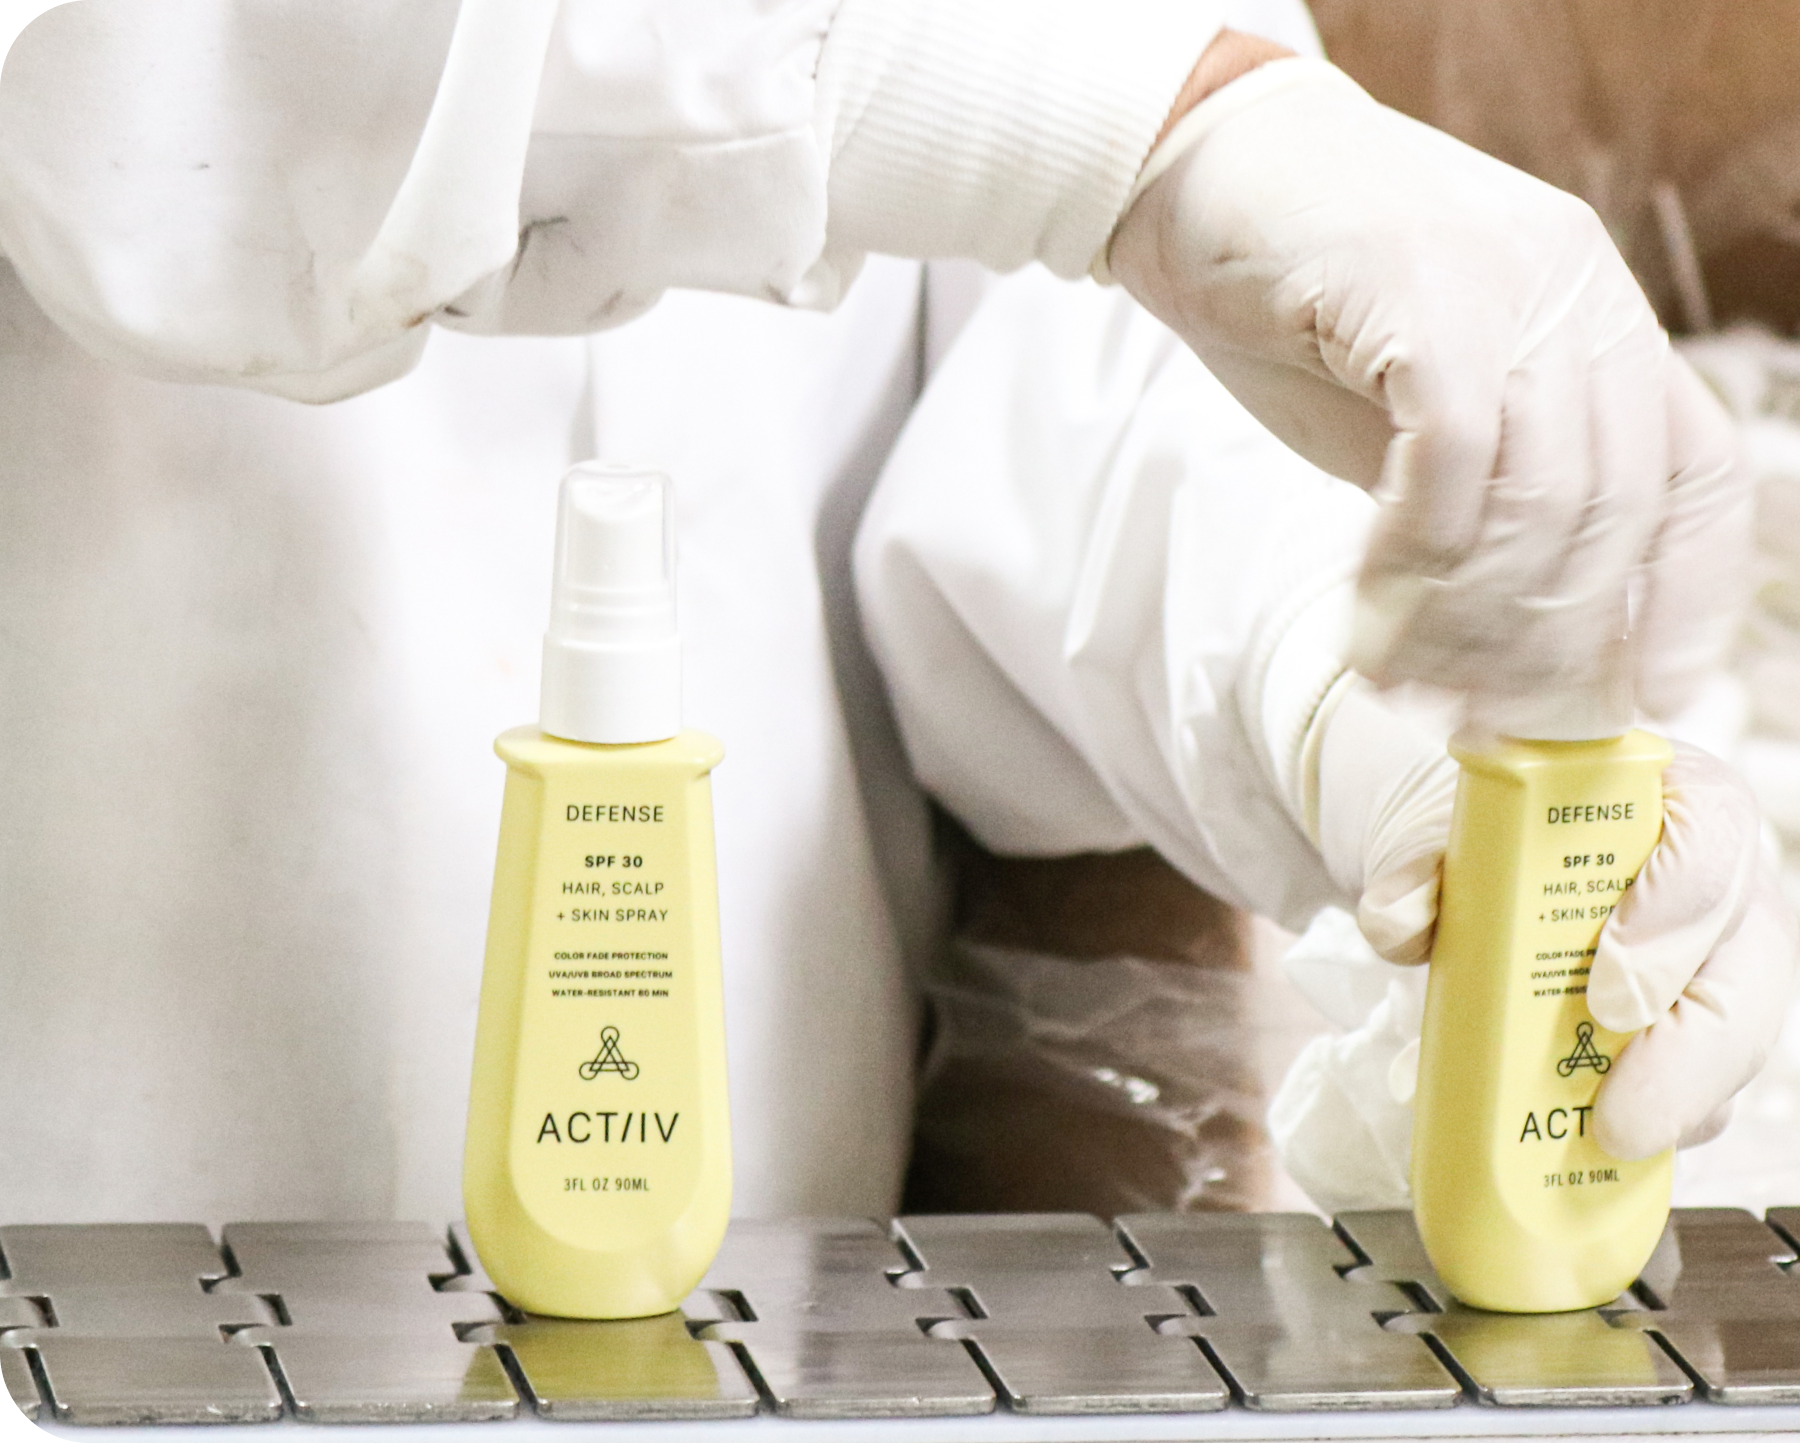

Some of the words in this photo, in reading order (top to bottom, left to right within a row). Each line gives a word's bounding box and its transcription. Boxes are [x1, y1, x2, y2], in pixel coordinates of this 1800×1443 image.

[566, 805, 664, 822] DEFENSE
[1548, 803, 1634, 824] DEFENSE
[585, 855, 616, 868] SPF
[622, 855, 643, 868] 30
[1563, 855, 1590, 868] SPF
[1597, 853, 1615, 866] 30
[562, 882, 606, 897] HAIR,
[612, 882, 664, 895] SCALP
[1544, 881, 1581, 895] HAIR,
[1587, 878, 1634, 892] SCALP
[557, 912, 565, 921] +
[571, 908, 610, 922] SKIN
[615, 908, 668, 922] SPRAY
[1551, 908, 1585, 922] SKIN
[554, 952, 584, 960] COLOR
[587, 952, 609, 960] FADE
[611, 952, 668, 960] PROTECTION
[1536, 951, 1562, 960] COLOR
[1565, 950, 1584, 958] FADE
[549, 970, 589, 979] UVA/UVB
[591, 970, 622, 978] BROAD
[624, 970, 673, 978] SPECTRUM
[552, 989, 636, 997] WATER-RESISTANT
[652, 989, 669, 997] MIN
[1520, 1106, 1593, 1142] ACT
[564, 1178, 586, 1191] 3FL
[592, 1178, 608, 1191] OZ
[615, 1178, 650, 1191] 90ML
[1544, 1174, 1563, 1187] 3FL
[1568, 1172, 1583, 1185] OZ
[1589, 1169, 1620, 1183] 90ML
